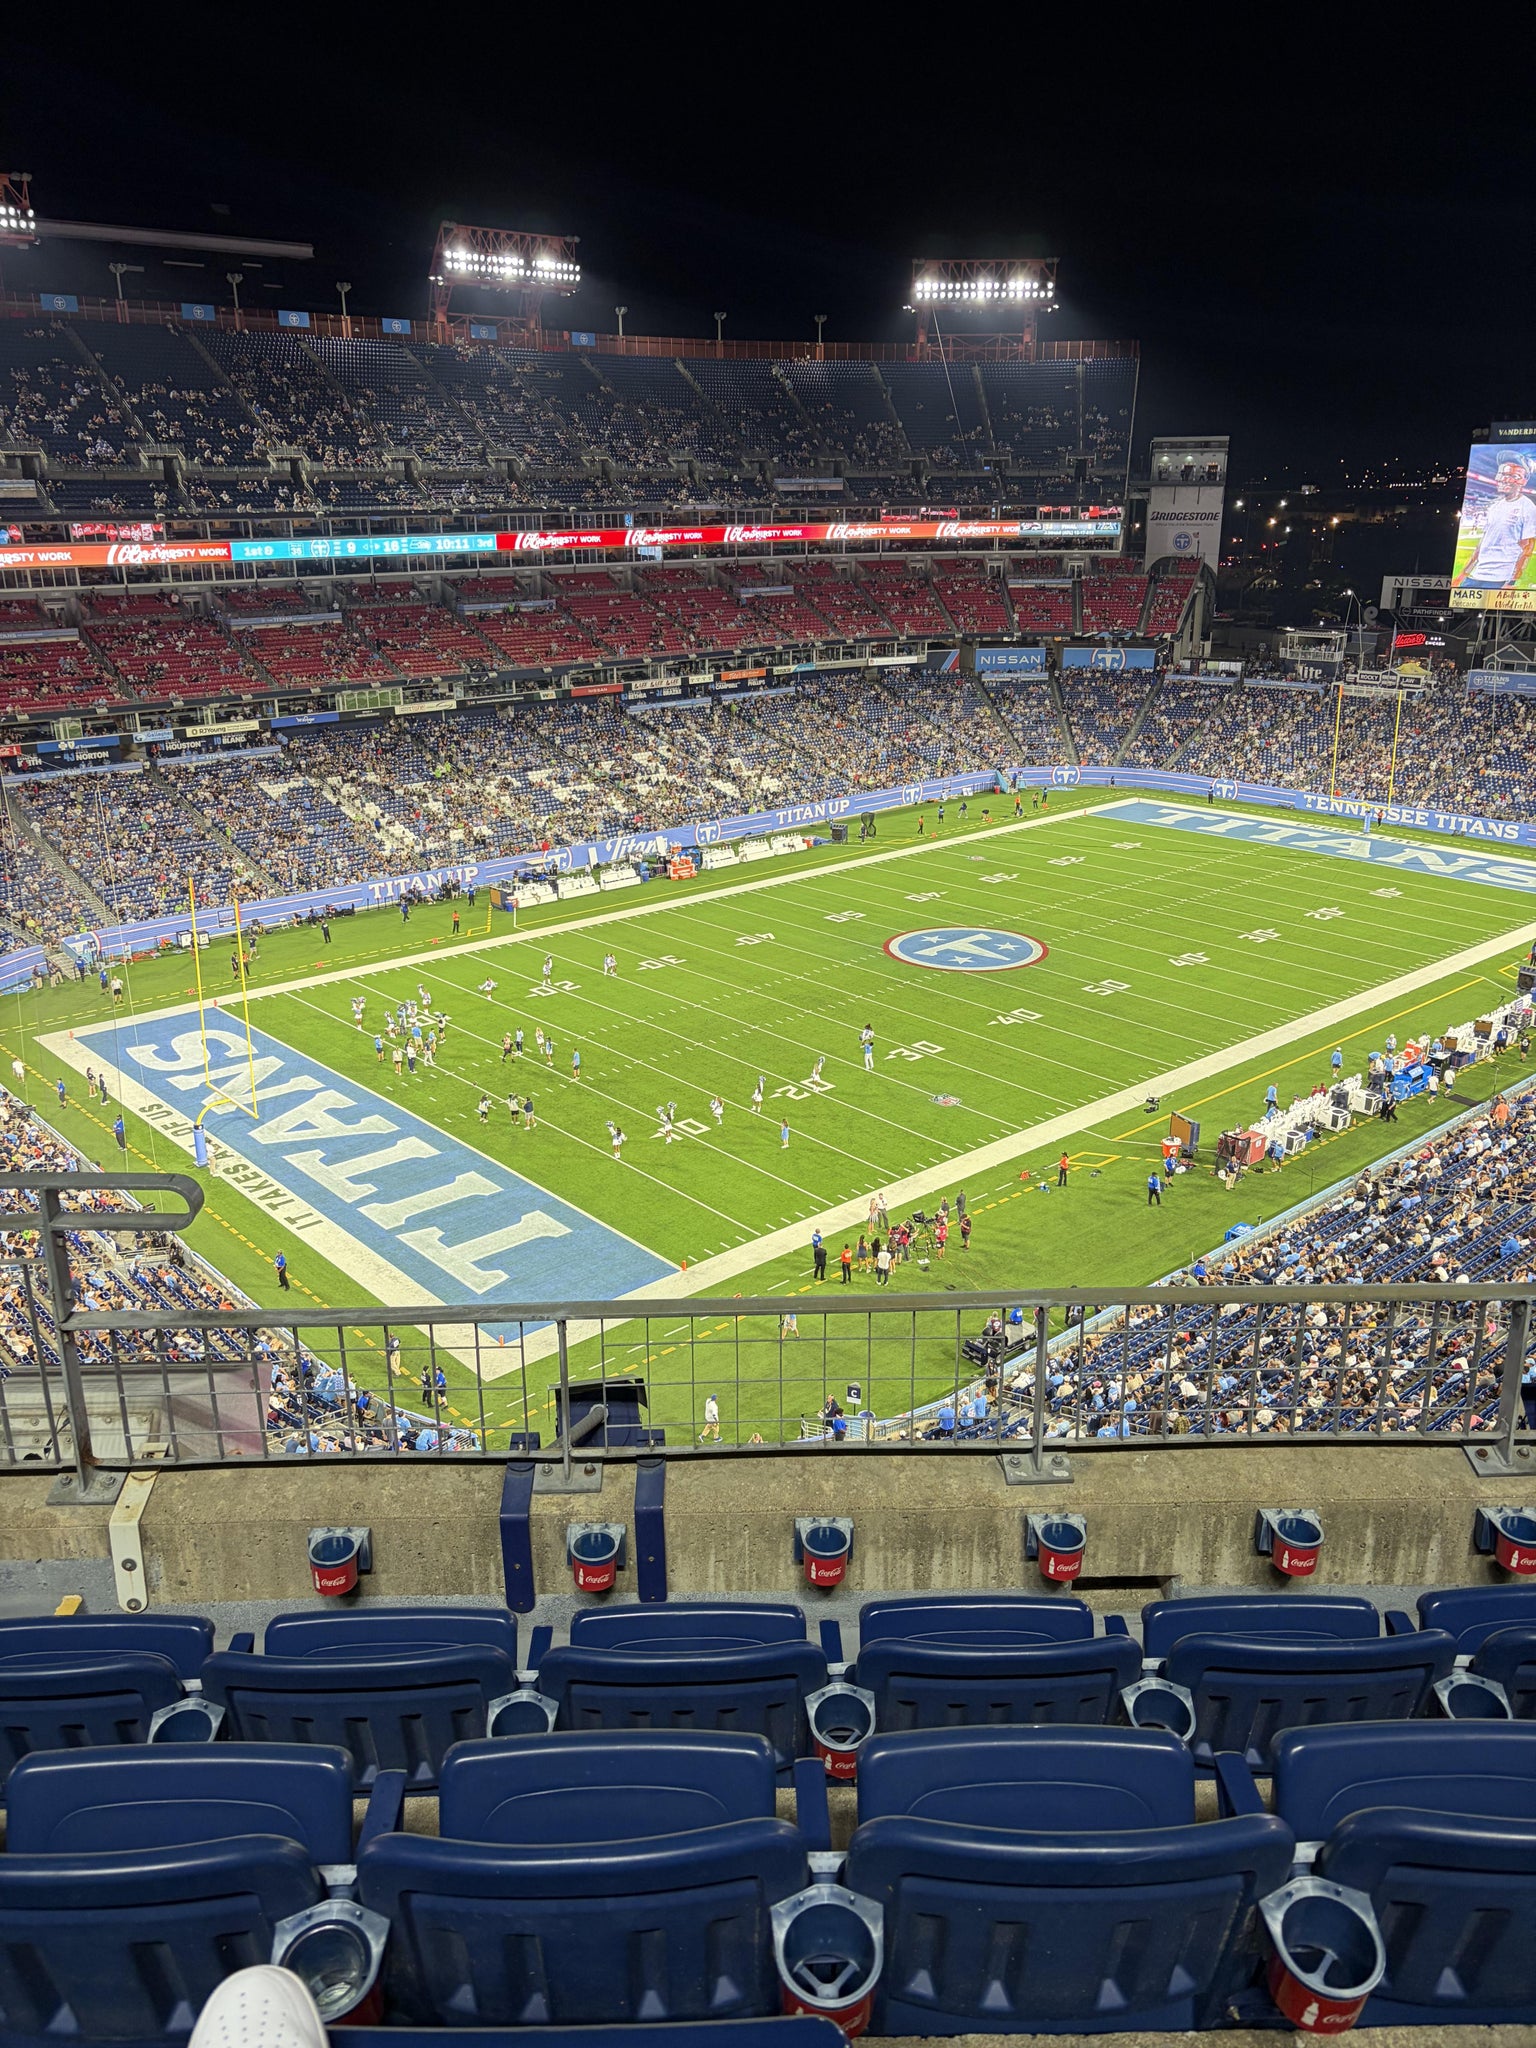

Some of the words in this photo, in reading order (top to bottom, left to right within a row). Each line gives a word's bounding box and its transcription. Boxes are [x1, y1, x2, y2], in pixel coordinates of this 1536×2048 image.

[1150, 511, 1221, 521] BRIDGESTONE
[244, 546, 263, 557] 1st
[346, 541, 356, 554] 9
[436, 538, 470, 550] 10:11
[476, 538, 493, 547] 3rd
[38, 551, 73, 562] WORK
[198, 548, 229, 556] WORK
[1453, 590, 1483, 600] MARS
[1412, 607, 1453, 616] PATHFINDER
[980, 655, 1042, 665] NISSAN
[199, 726, 226, 734] RJYoung
[165, 741, 202, 751] HOUSTON
[76, 751, 109, 761] NORTON
[776, 804, 826, 825] TITAN
[828, 799, 851, 815] UP
[1303, 793, 1429, 826] TENNESSEE
[1434, 813, 1520, 840] TITANS
[606, 836, 660, 861] Titan
[368, 871, 443, 899] TITAN
[1303, 907, 1346, 921] 20
[1237, 928, 1282, 943] 30
[638, 954, 688, 970] 30
[1169, 952, 1212, 967] 40
[528, 980, 582, 997] 20
[1081, 979, 1132, 996] 50
[996, 1008, 1044, 1025] 40
[888, 1040, 946, 1062] 30
[776, 1077, 837, 1100] 20
[138, 1102, 175, 1120] US
[125, 1029, 574, 1295] TITANS
[222, 1163, 296, 1211] TAKES
[284, 1212, 324, 1231] IT
[850, 1389, 858, 1398] C
